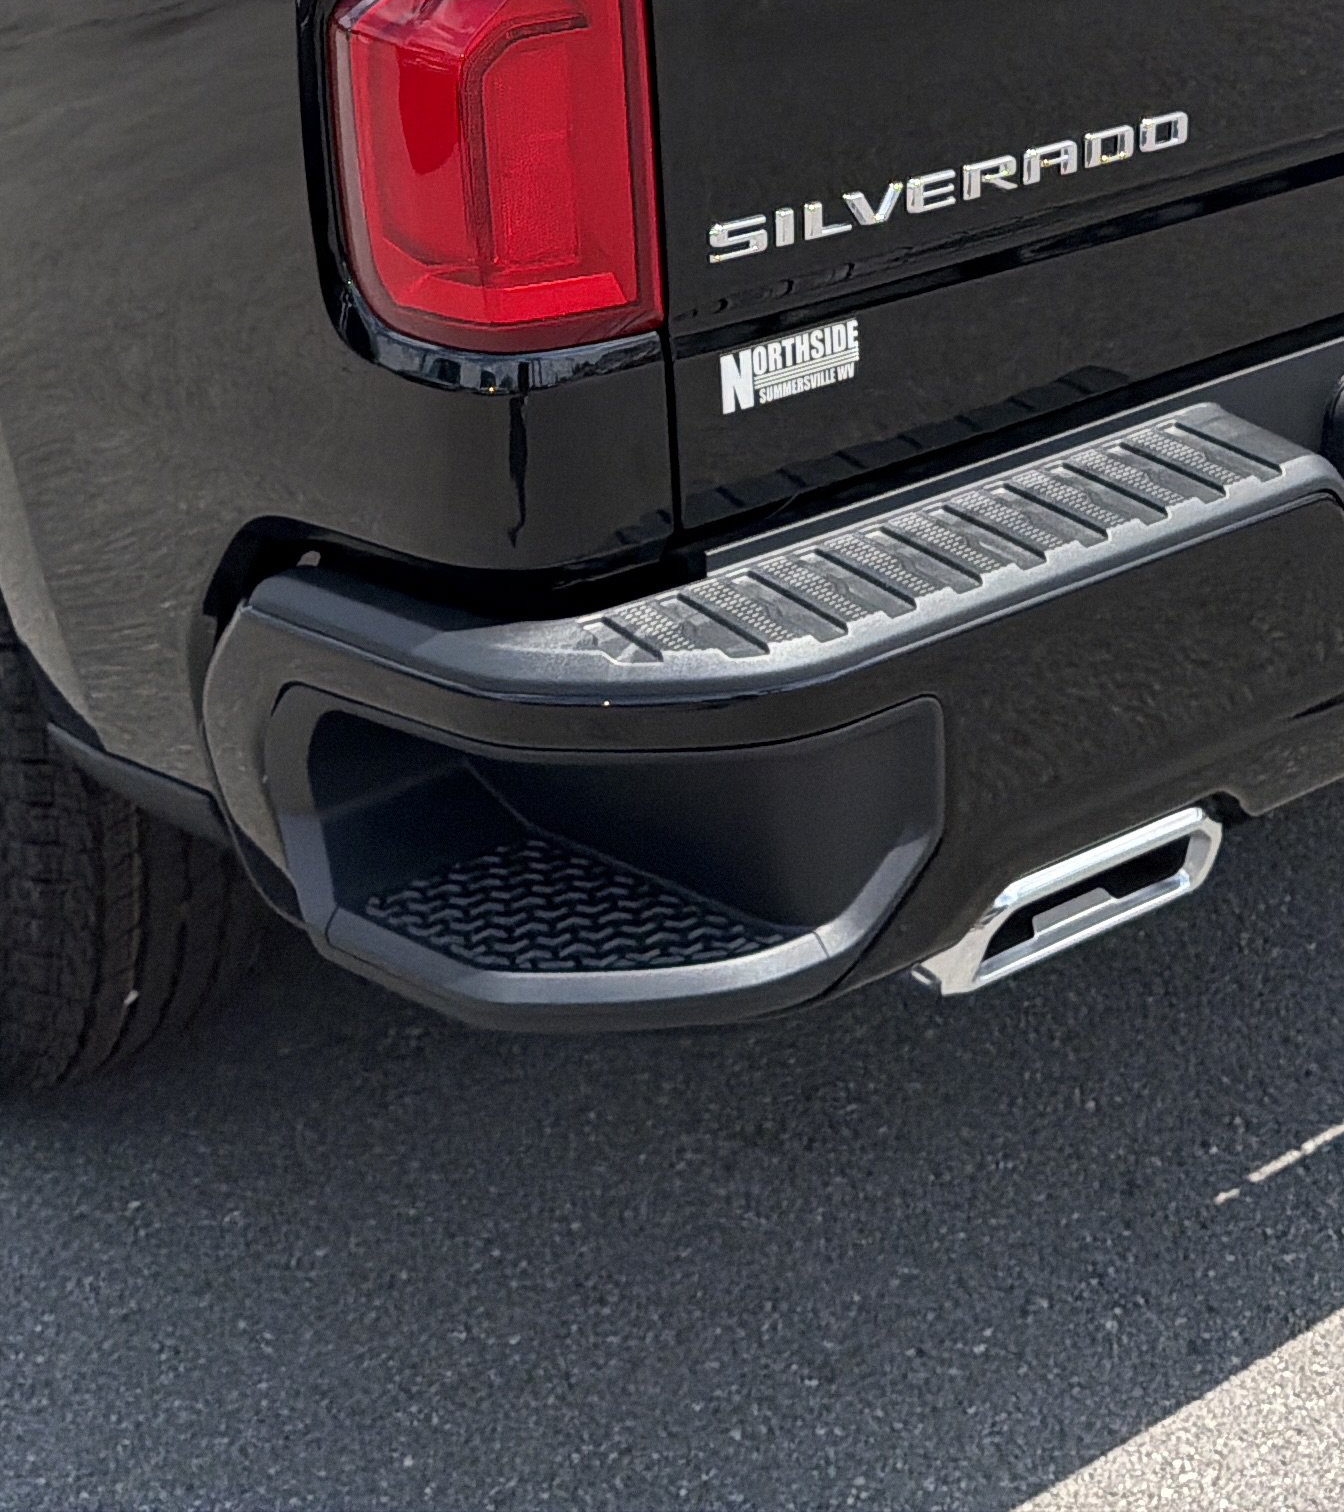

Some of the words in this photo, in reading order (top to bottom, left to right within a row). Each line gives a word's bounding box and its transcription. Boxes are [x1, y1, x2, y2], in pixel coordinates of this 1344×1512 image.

[709, 111, 1189, 263] SILVERADO
[720, 319, 859, 415] NORTHSIDE
[759, 368, 837, 404] SUMMERSVILLE
[837, 362, 855, 383] WV
